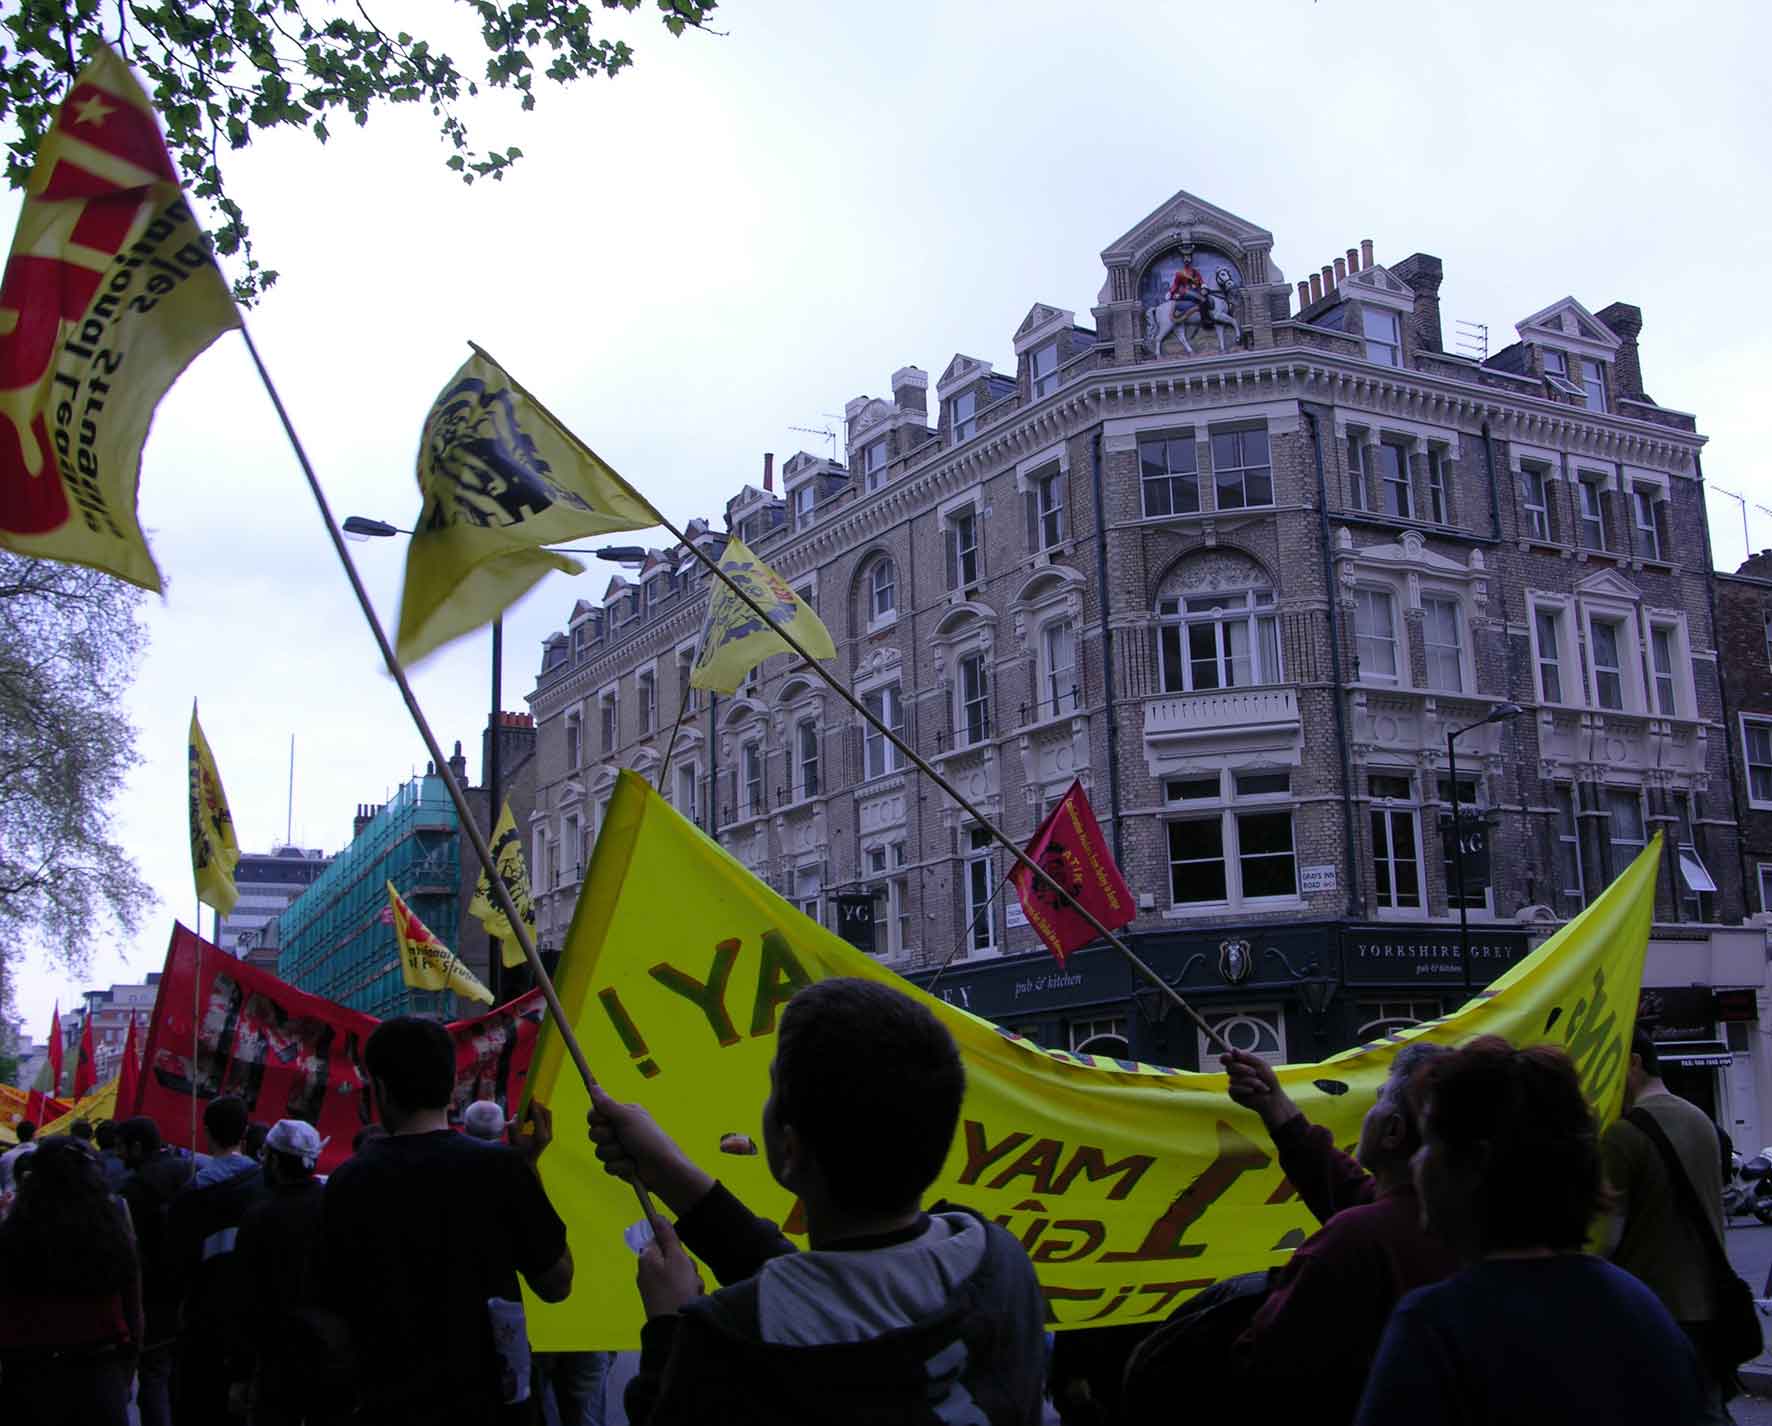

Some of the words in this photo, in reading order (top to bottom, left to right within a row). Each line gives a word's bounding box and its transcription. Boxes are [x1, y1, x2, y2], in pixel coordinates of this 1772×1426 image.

[843, 904, 870, 921] YG
[1359, 944, 1462, 958] YORKSHIRE
[1470, 945, 1513, 960] GREY
[1015, 978, 1033, 999] pub
[1034, 976, 1047, 991] &
[1048, 971, 1082, 989] kitchen
[943, 985, 973, 1008] EY
